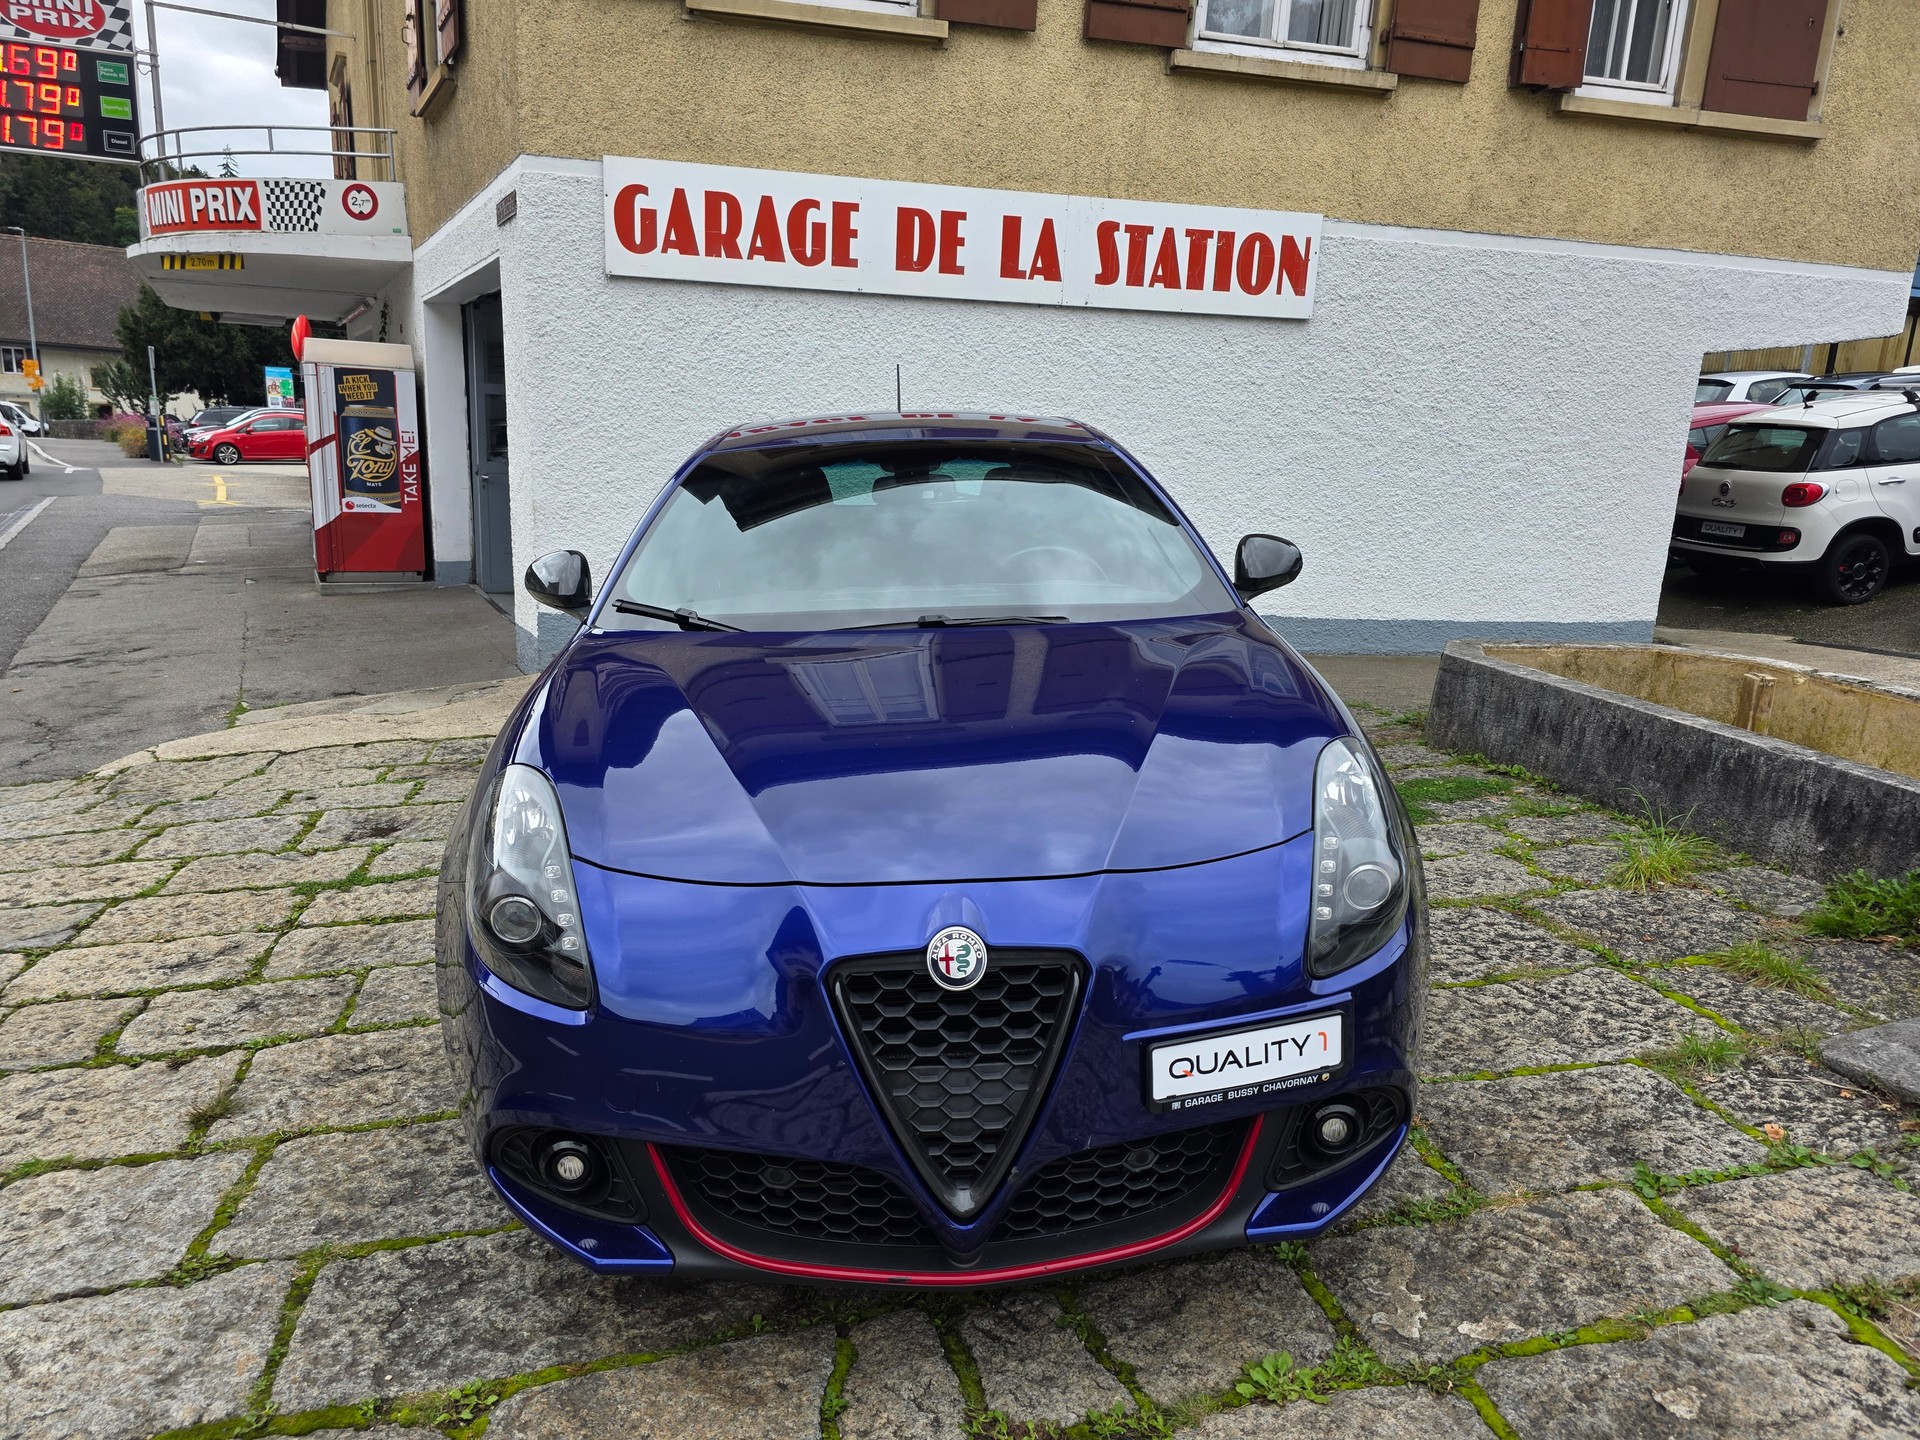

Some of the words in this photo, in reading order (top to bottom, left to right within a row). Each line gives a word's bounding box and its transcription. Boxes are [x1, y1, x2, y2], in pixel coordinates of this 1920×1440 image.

[9, 5, 96, 31] PRIX
[149, 189, 185, 227] MINI
[189, 187, 257, 223] PRIX
[612, 183, 860, 268] GARAGE
[895, 206, 967, 275] DE
[1000, 215, 1062, 282] LA
[1094, 220, 1311, 297] STATION
[339, 385, 362, 393] WHEN
[362, 383, 377, 391] YOU
[352, 376, 369, 384] KICK
[346, 392, 365, 400] NEED
[366, 391, 373, 399] IT
[401, 430, 416, 460] ME!
[347, 453, 395, 481] Tony
[403, 463, 418, 504] TAKE
[931, 936, 948, 960] ALFA
[952, 933, 982, 959] ROMEO
[1184, 1093, 1223, 1108] GARAGE
[1228, 1086, 1259, 1100] BUSSY
[1263, 1074, 1319, 1093] CHAVORNAY
